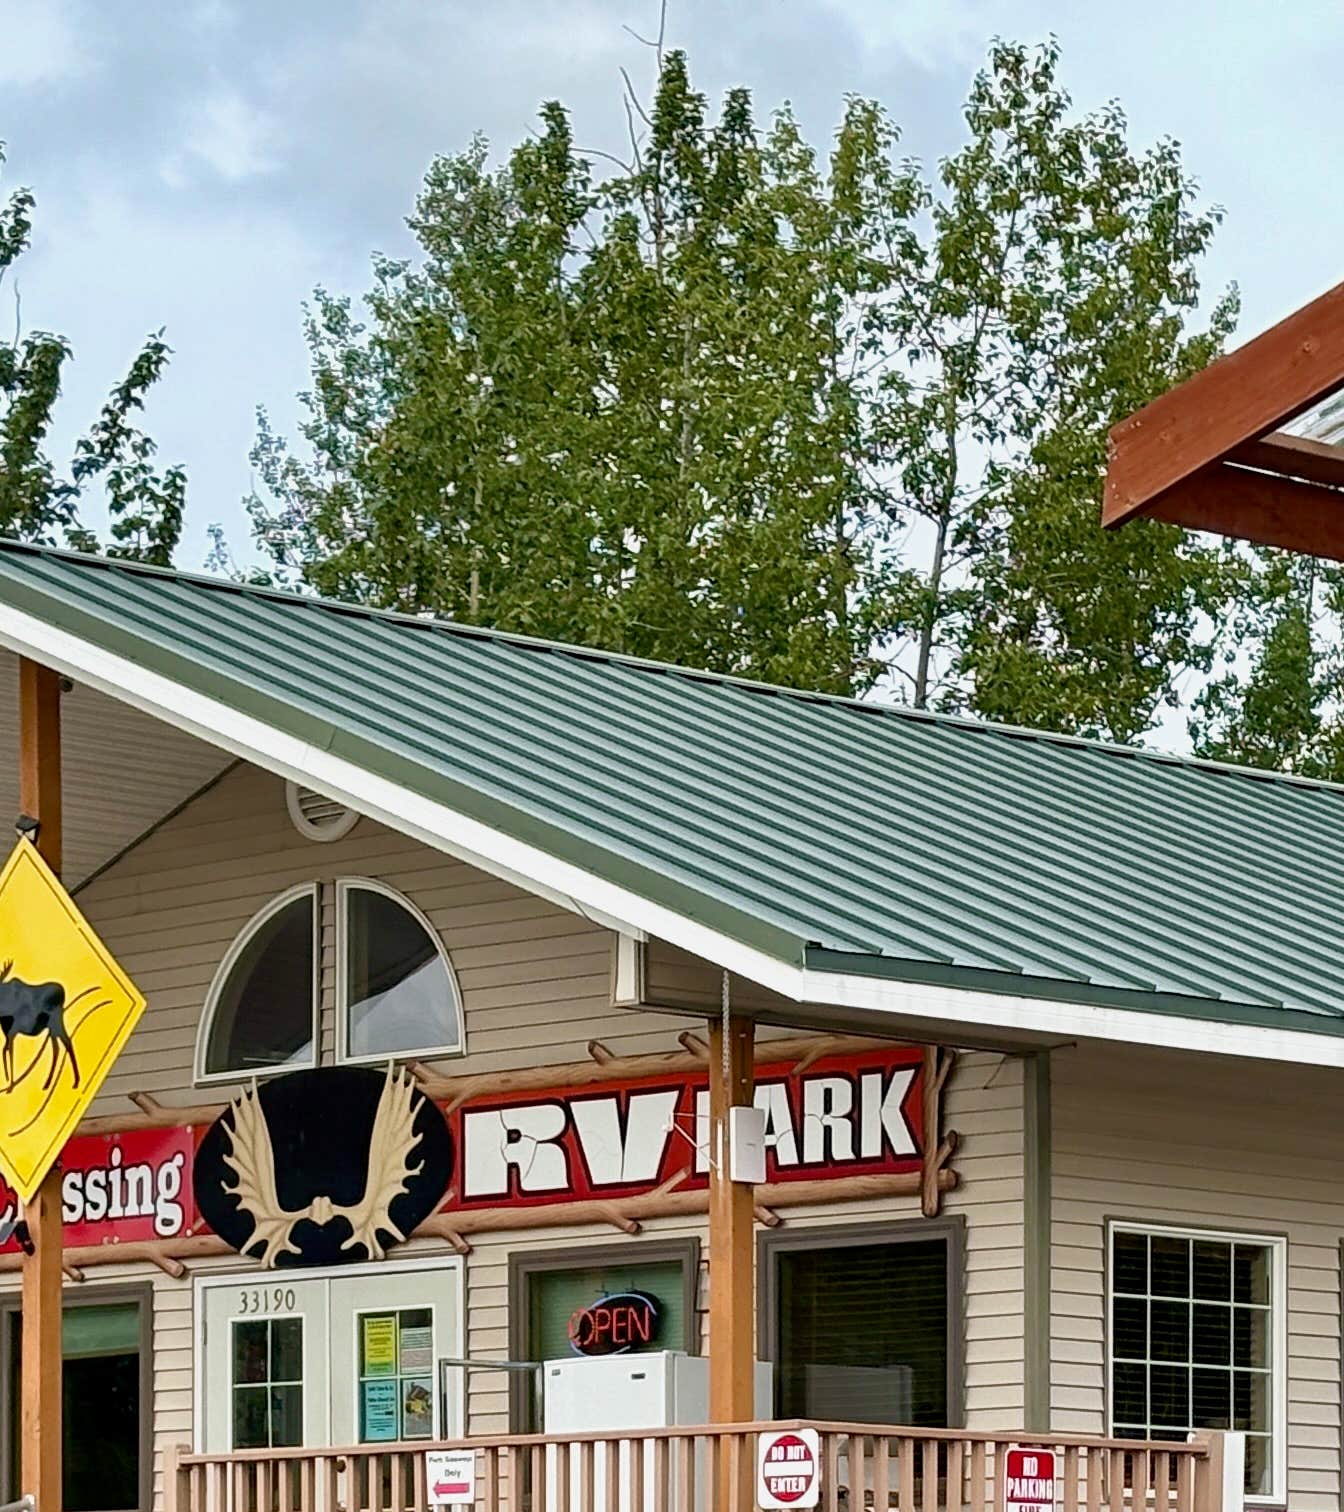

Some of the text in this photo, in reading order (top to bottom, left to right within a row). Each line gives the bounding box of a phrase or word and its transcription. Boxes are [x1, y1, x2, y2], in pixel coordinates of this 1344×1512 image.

[464, 1069, 917, 1197] RV ARK
[238, 1288, 296, 1314] 33190
[567, 1306, 651, 1347] OPEN
[771, 1445, 806, 1461] DO NOT
[1022, 1457, 1038, 1477] NO
[770, 1477, 806, 1493] ENTER
[1007, 1477, 1053, 1500] PARKING
